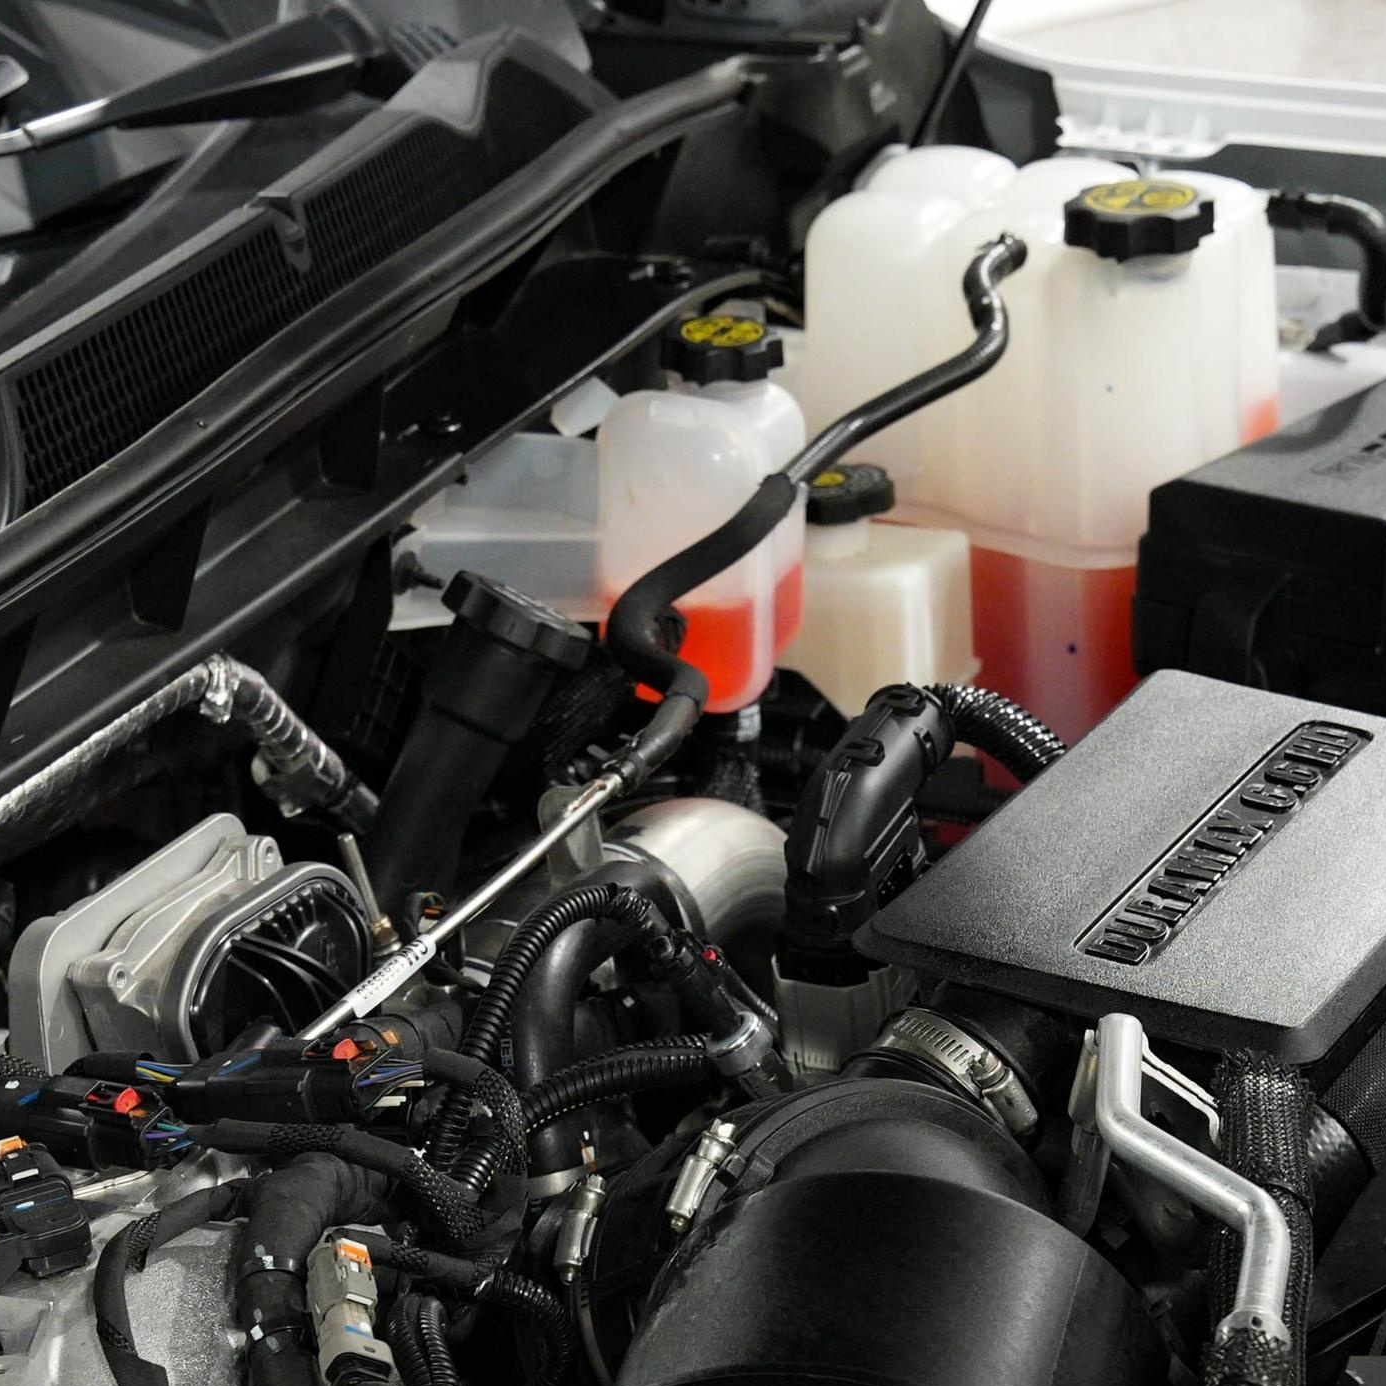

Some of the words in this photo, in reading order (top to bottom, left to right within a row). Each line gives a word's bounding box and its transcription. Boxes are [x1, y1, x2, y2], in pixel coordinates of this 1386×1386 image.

[1085, 809, 1274, 966] DURAMAX
[1240, 760, 1323, 814] 6.6
[1284, 727, 1361, 766] HD
[396, 940, 429, 966] GM
